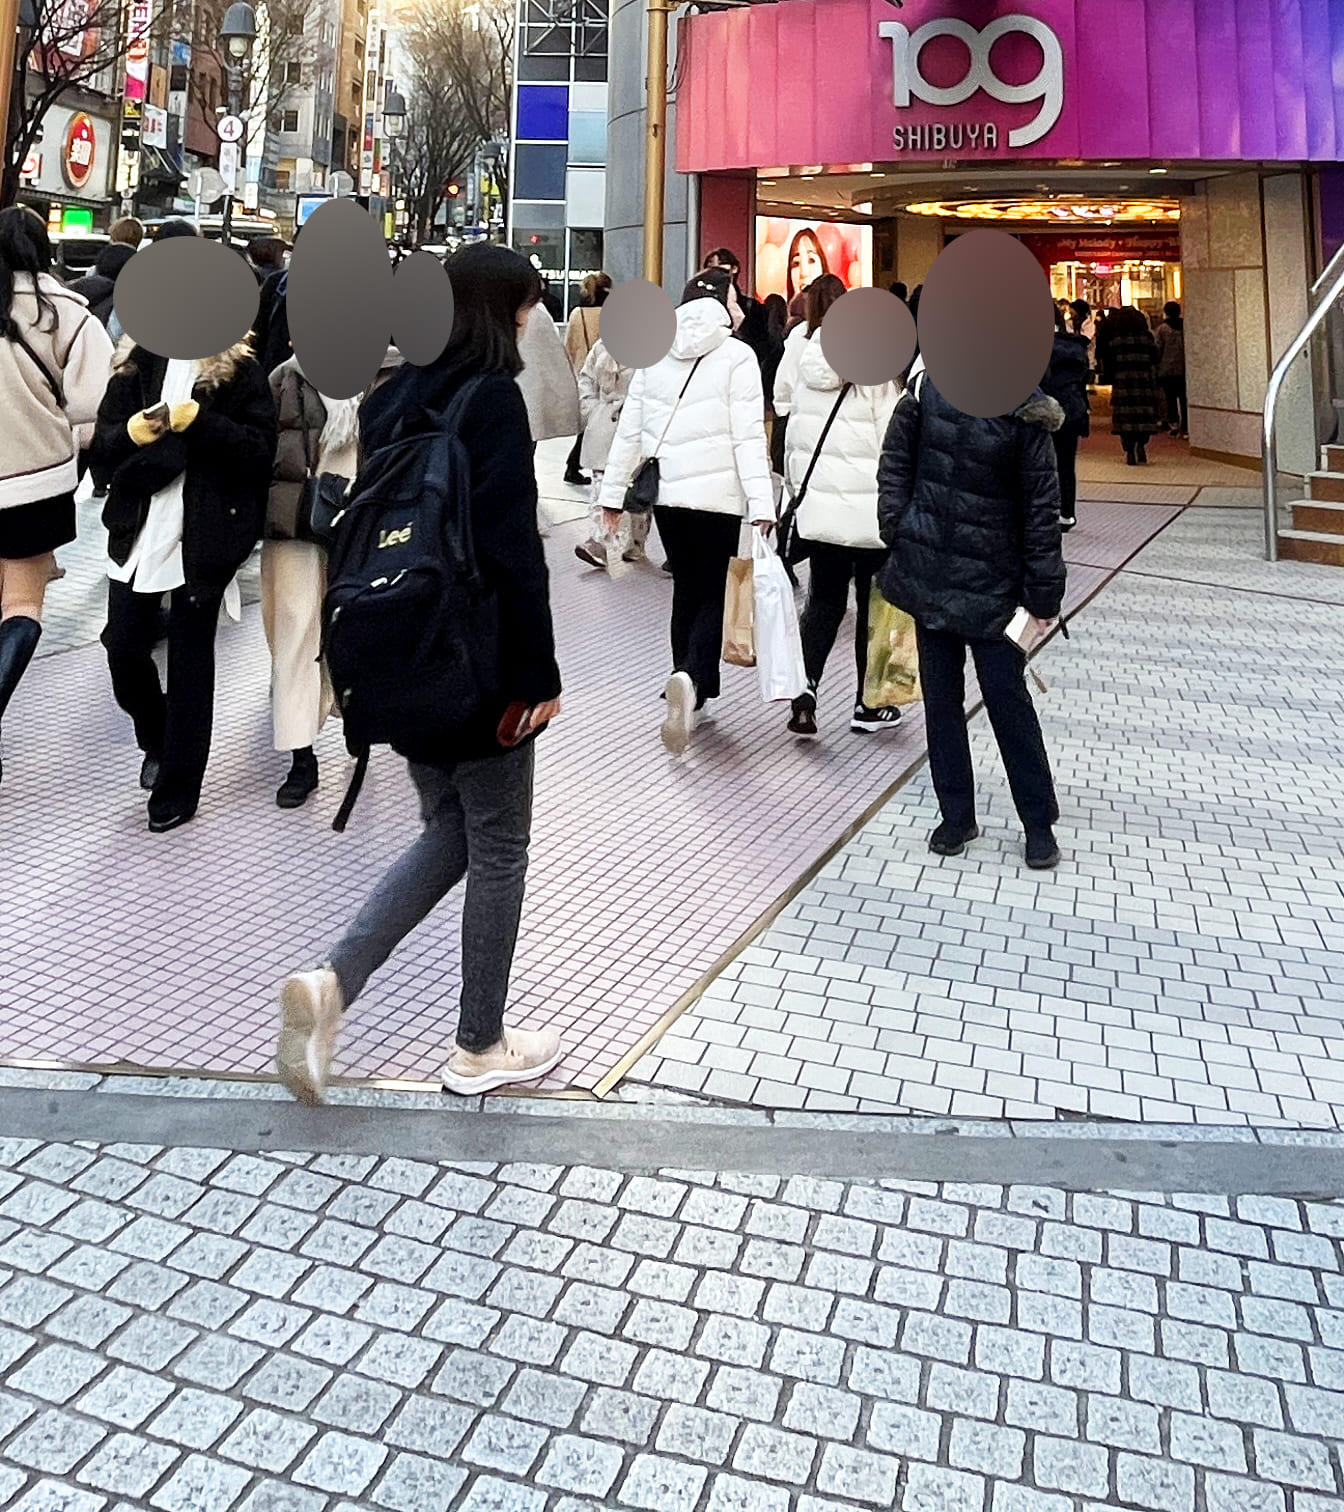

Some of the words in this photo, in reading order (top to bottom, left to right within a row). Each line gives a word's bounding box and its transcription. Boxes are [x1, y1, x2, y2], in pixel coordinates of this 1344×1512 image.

[878, 14, 1064, 147] 109
[223, 120, 234, 137] 4
[893, 123, 997, 150] SHIBUYA
